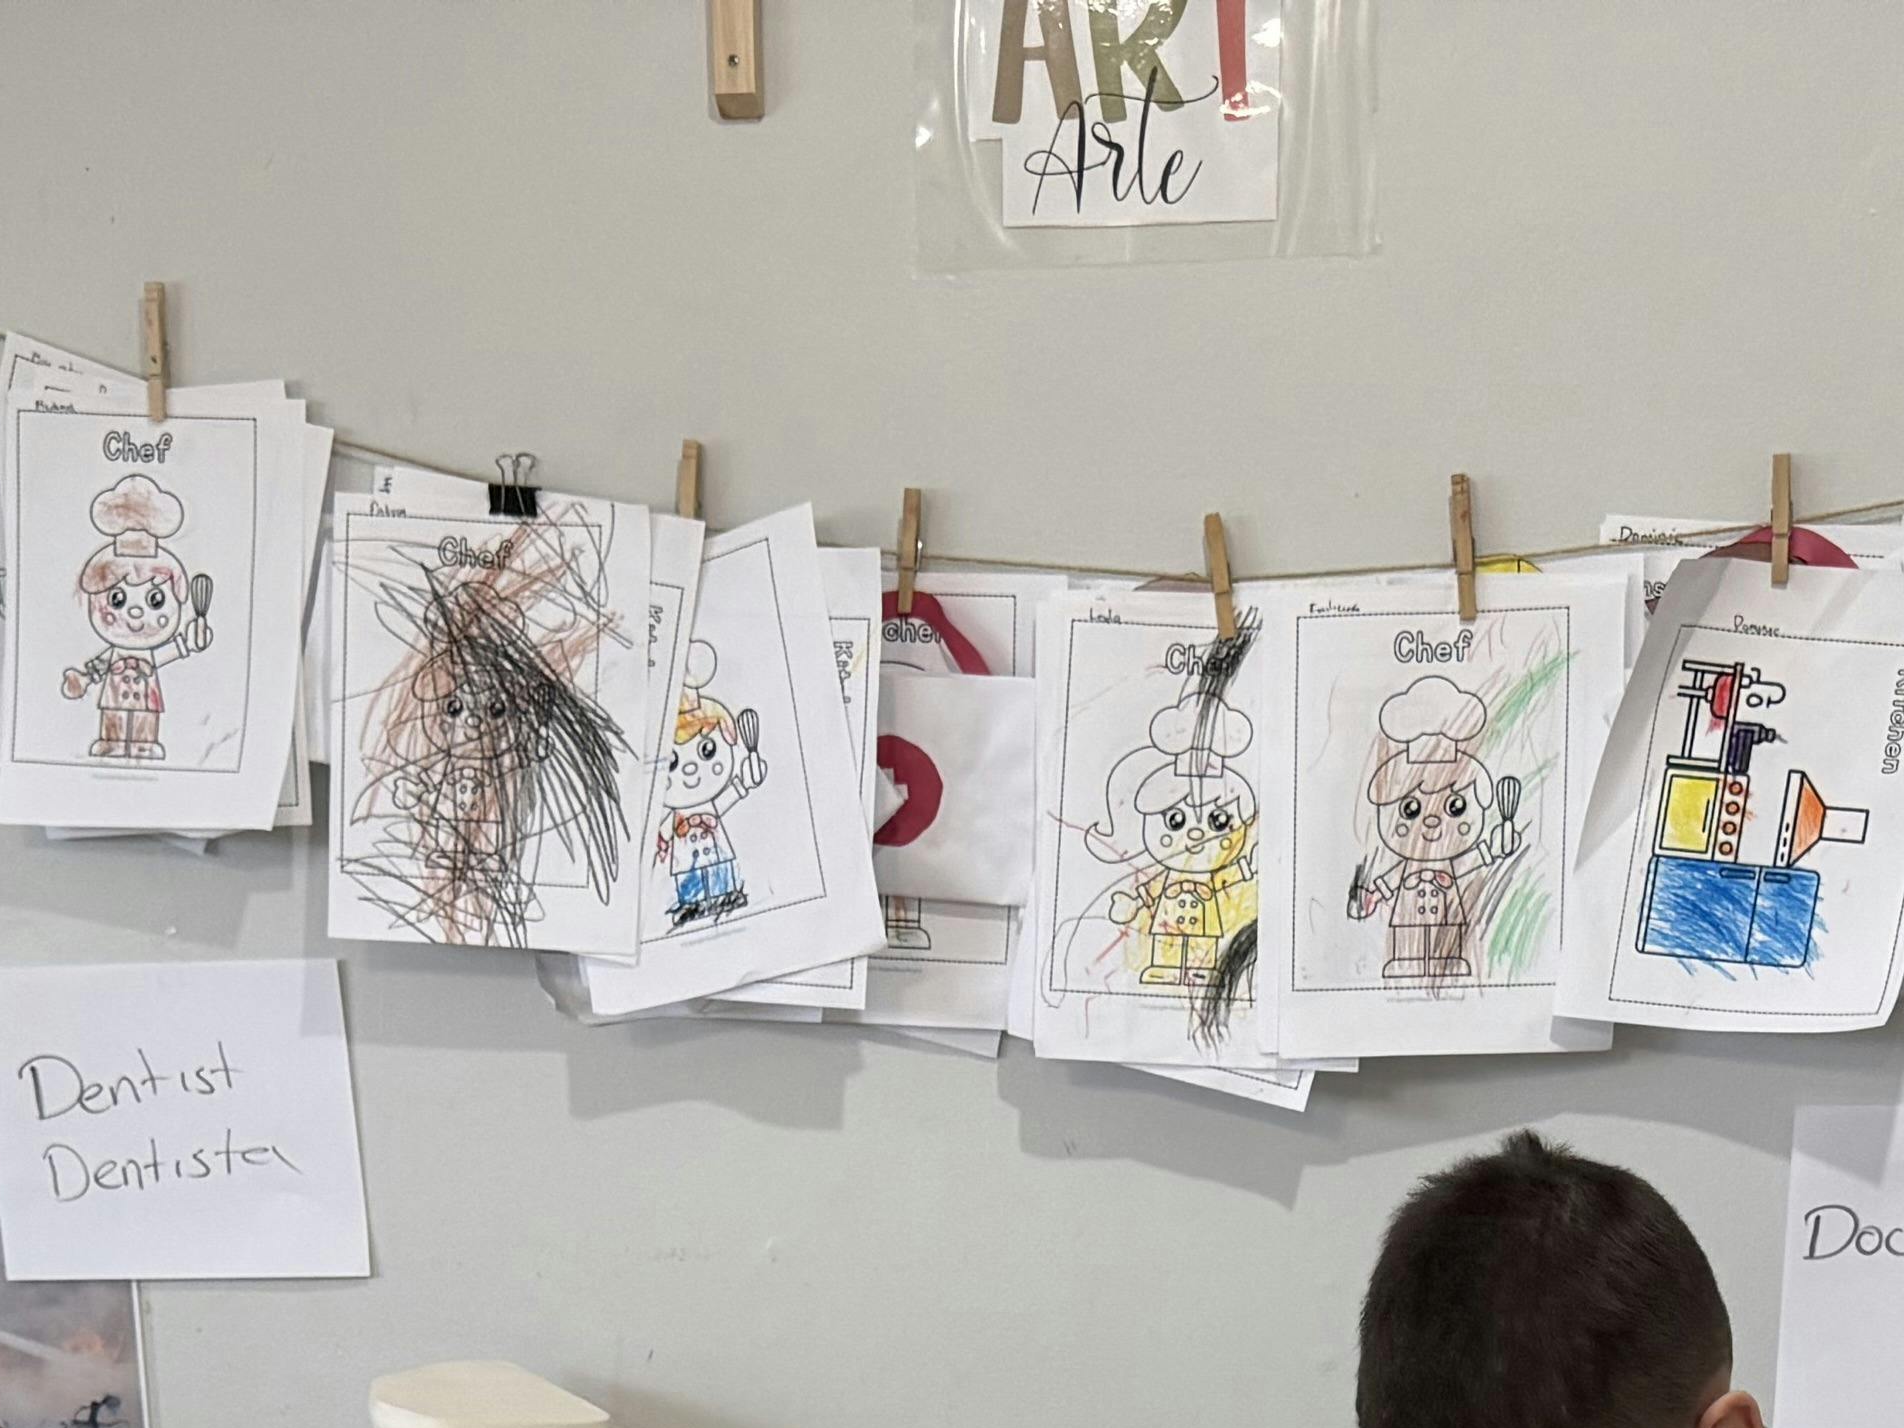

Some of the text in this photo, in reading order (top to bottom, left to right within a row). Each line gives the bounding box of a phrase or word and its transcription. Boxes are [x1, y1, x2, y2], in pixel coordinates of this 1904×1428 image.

[1024, 66, 1220, 216] Arte
[102, 429, 174, 464] Chef
[437, 535, 514, 571] Chef
[1394, 630, 1474, 664] Chef
[17, 1040, 245, 1121] Dentist
[42, 1127, 304, 1203] Dentista
